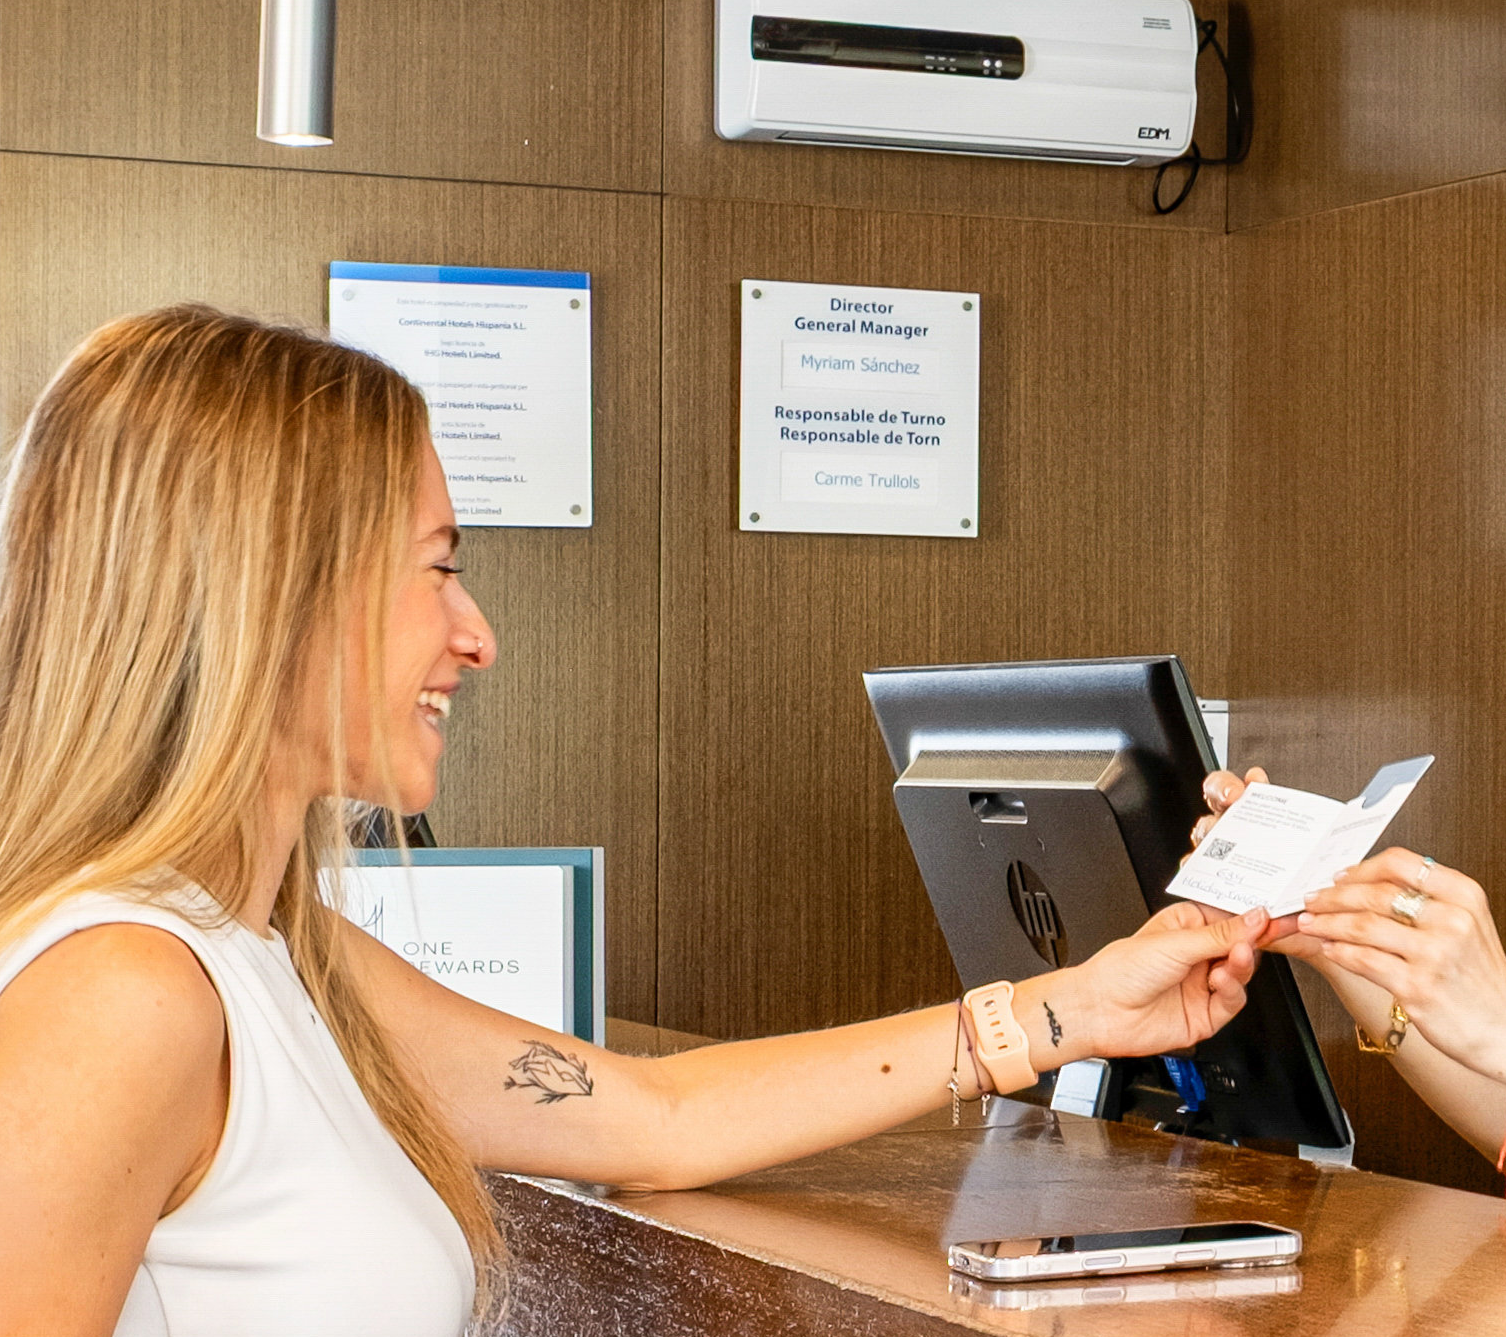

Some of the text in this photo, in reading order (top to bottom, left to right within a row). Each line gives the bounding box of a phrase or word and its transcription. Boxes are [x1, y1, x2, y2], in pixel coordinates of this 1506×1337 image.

[1138, 127, 1169, 140] EDM
[830, 298, 894, 314] Director
[399, 318, 446, 327] Continental
[448, 319, 474, 328] Hotels
[476, 320, 511, 330] Hispania
[794, 317, 929, 340] General Manager
[441, 350, 467, 358] Hotels
[801, 354, 920, 375] Myriam Sánchez
[449, 402, 474, 410] Hotels
[476, 402, 511, 411] Hispania
[775, 406, 946, 426] Responsable de Turno
[442, 432, 467, 440] Hotels
[780, 426, 940, 446] Responsable de Torn
[449, 474, 474, 482] Hotels
[476, 474, 512, 484] Hispania
[814, 471, 920, 489] Carme Trullols
[470, 507, 502, 515] Limited
[403, 942, 453, 955] ONE
[412, 960, 520, 974] EWARDS
